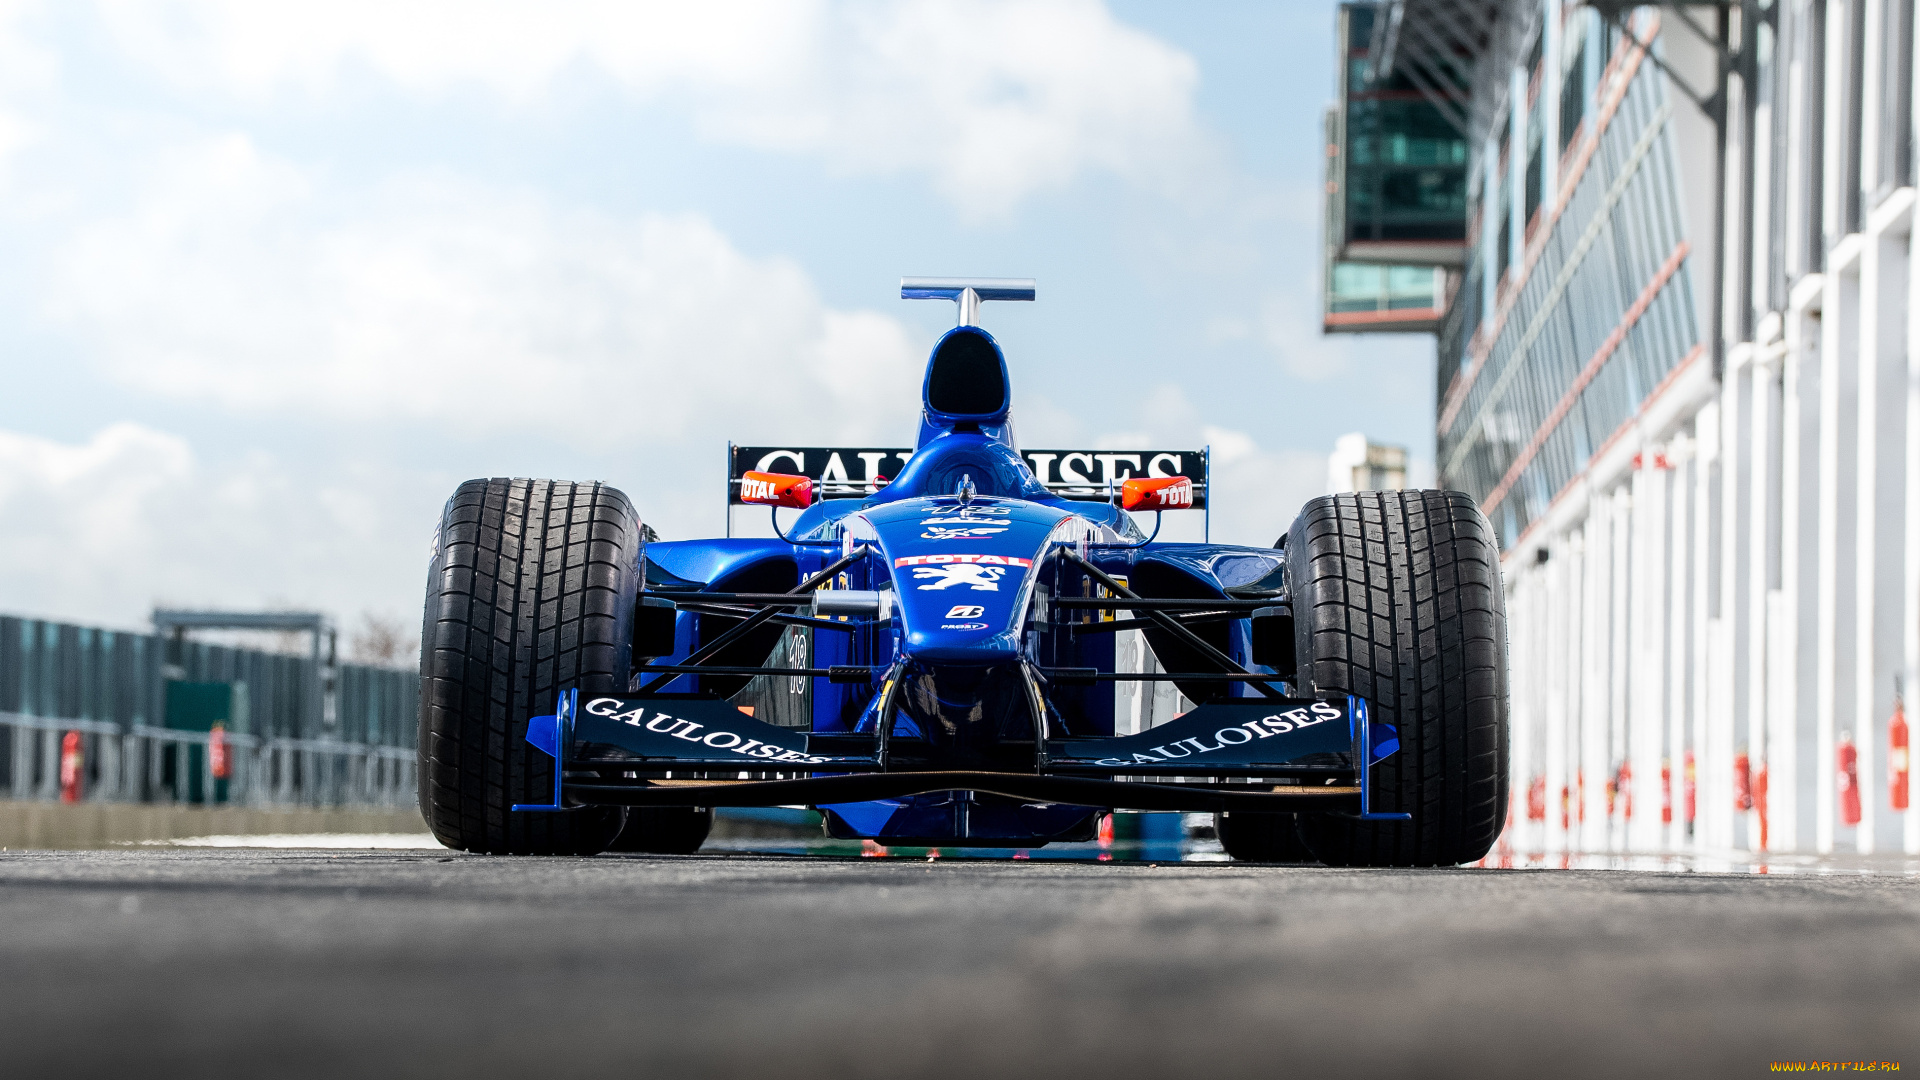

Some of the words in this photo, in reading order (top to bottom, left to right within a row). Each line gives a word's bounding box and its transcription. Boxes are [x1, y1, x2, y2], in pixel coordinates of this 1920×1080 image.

[754, 450, 1182, 495] GAUISES
[1157, 484, 1192, 505] TOTA
[900, 554, 1030, 568] TOTAL
[585, 697, 833, 764] GAULOISES
[1094, 701, 1342, 767] GAULOISES
